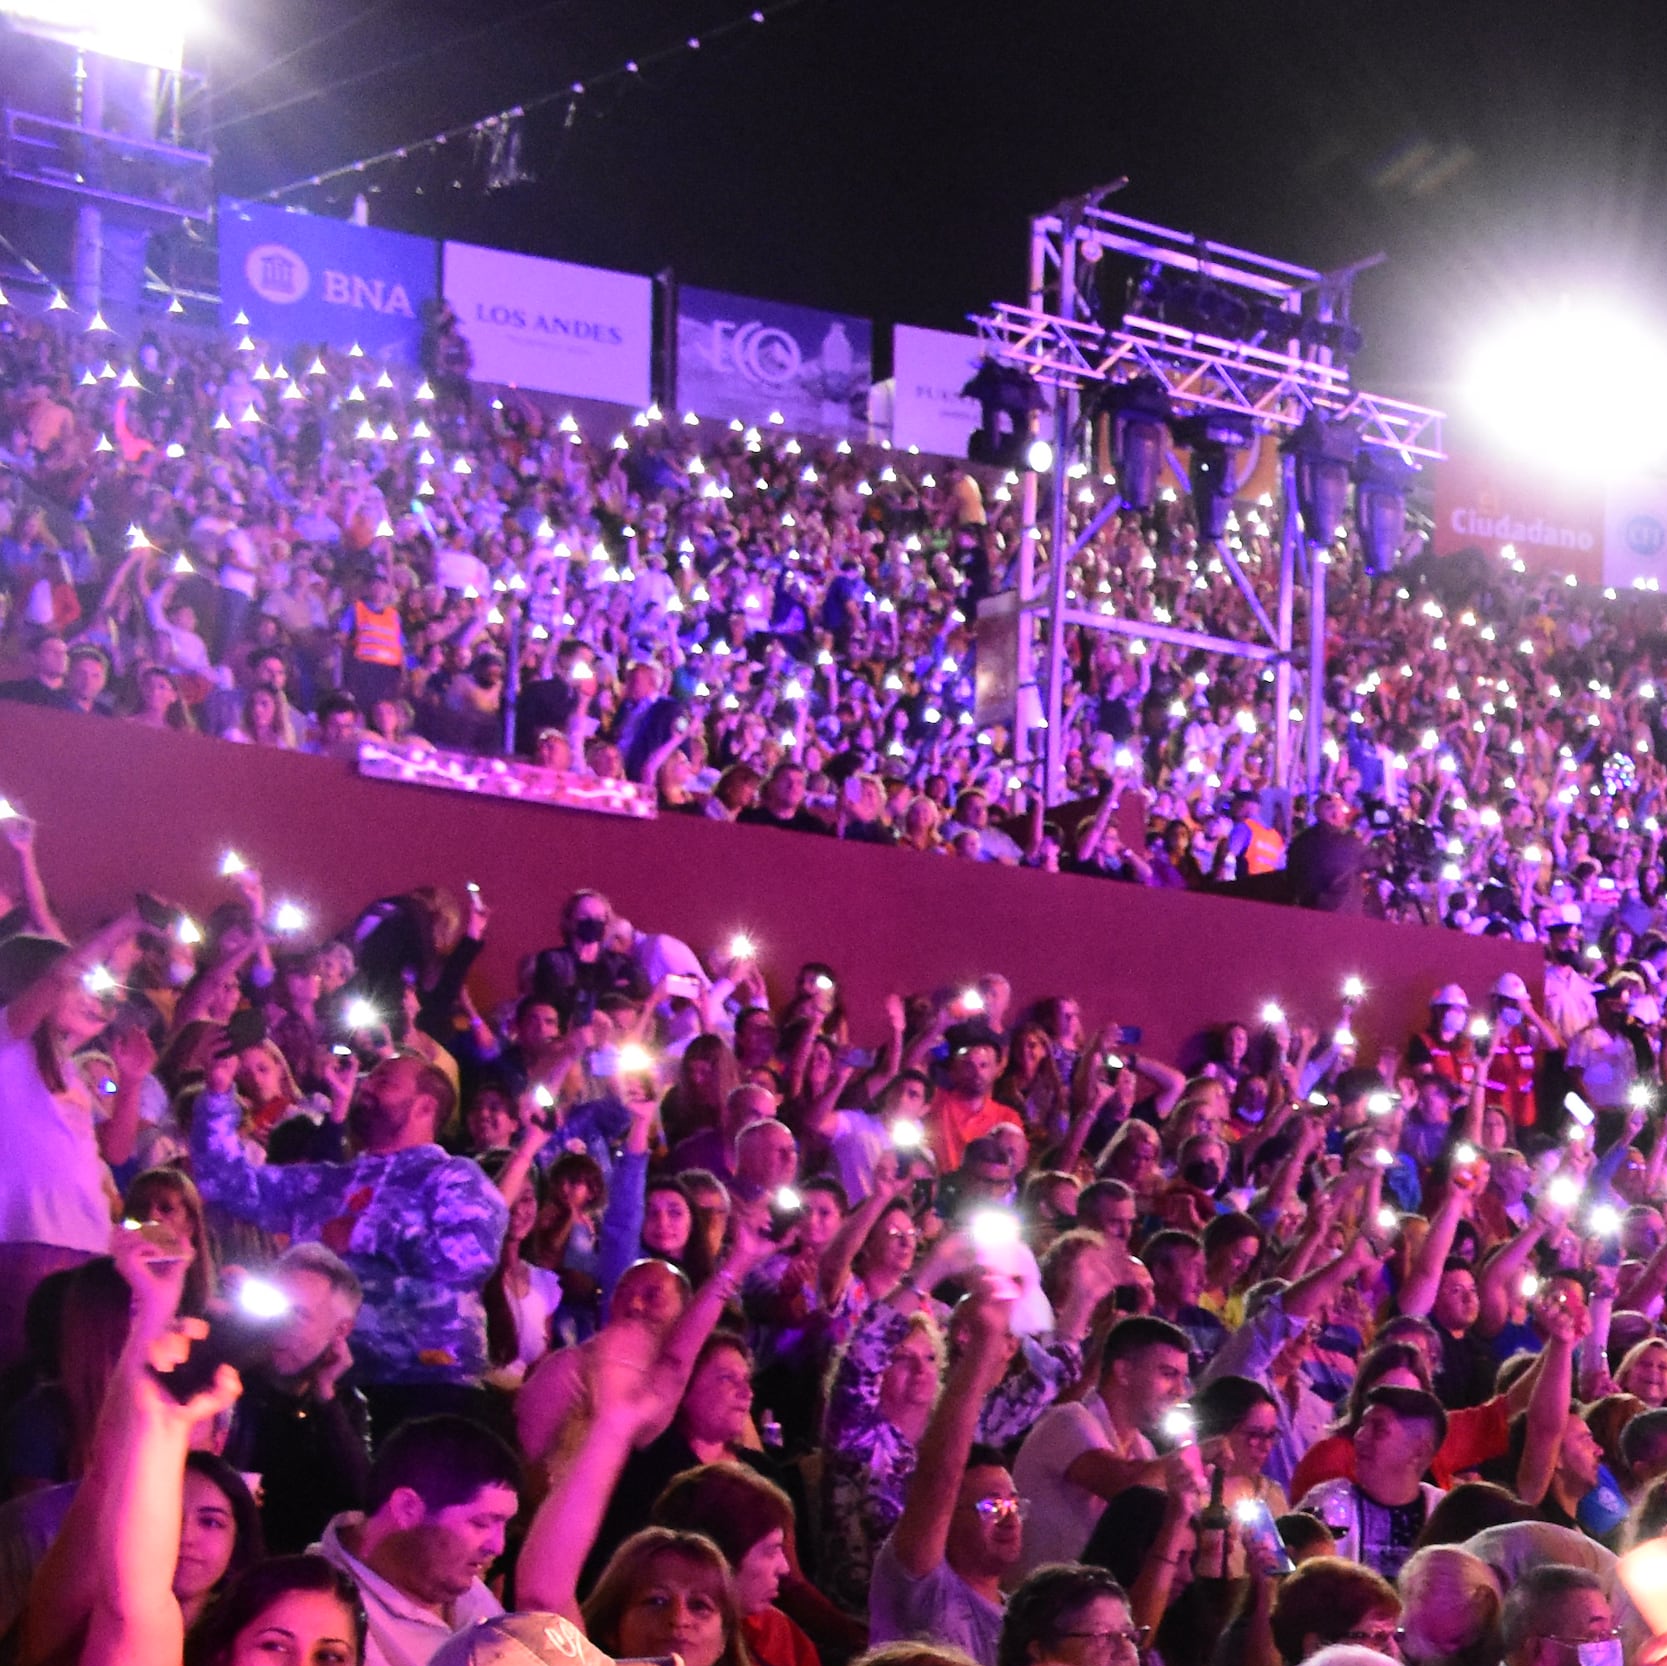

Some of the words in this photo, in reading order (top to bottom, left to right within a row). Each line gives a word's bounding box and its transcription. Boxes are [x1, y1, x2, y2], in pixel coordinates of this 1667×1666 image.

[323, 270, 417, 319] BNA
[476, 303, 527, 329] LOS
[533, 313, 623, 345] ANDES
[1450, 505, 1596, 552] Ciudadano
